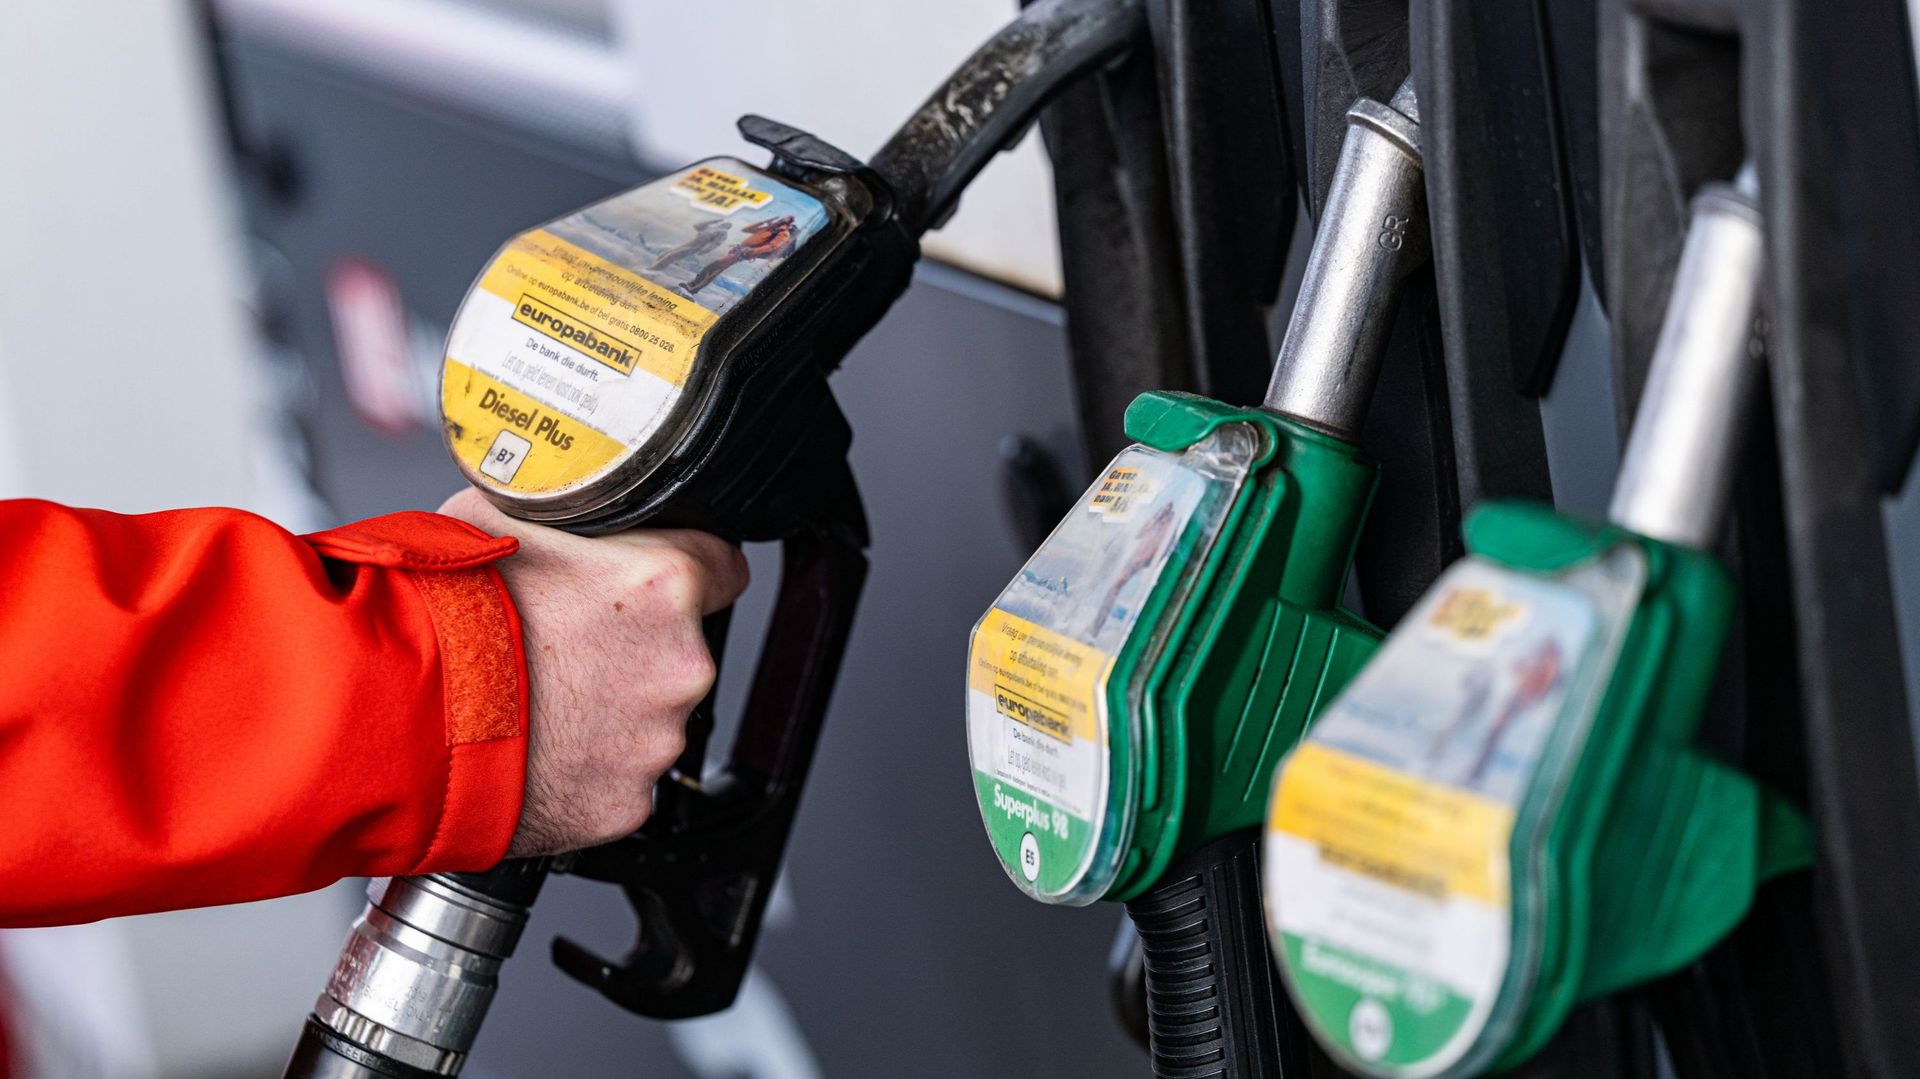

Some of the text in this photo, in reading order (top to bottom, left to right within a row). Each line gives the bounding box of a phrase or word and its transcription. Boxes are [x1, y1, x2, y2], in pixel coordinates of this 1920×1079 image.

[561, 271, 575, 284] op
[536, 280, 591, 312] europabank.be
[607, 315, 630, 333] gratis
[629, 323, 650, 341] 0800
[519, 302, 636, 369] europabank
[525, 337, 599, 383] De bank die durft.
[478, 387, 539, 432] Diesel
[533, 414, 576, 452] Plus
[495, 447, 516, 466] B7
[997, 693, 1070, 735] europabank
[993, 783, 1050, 832] Superplus
[1051, 809, 1070, 841] 98
[1025, 848, 1036, 867] E5
